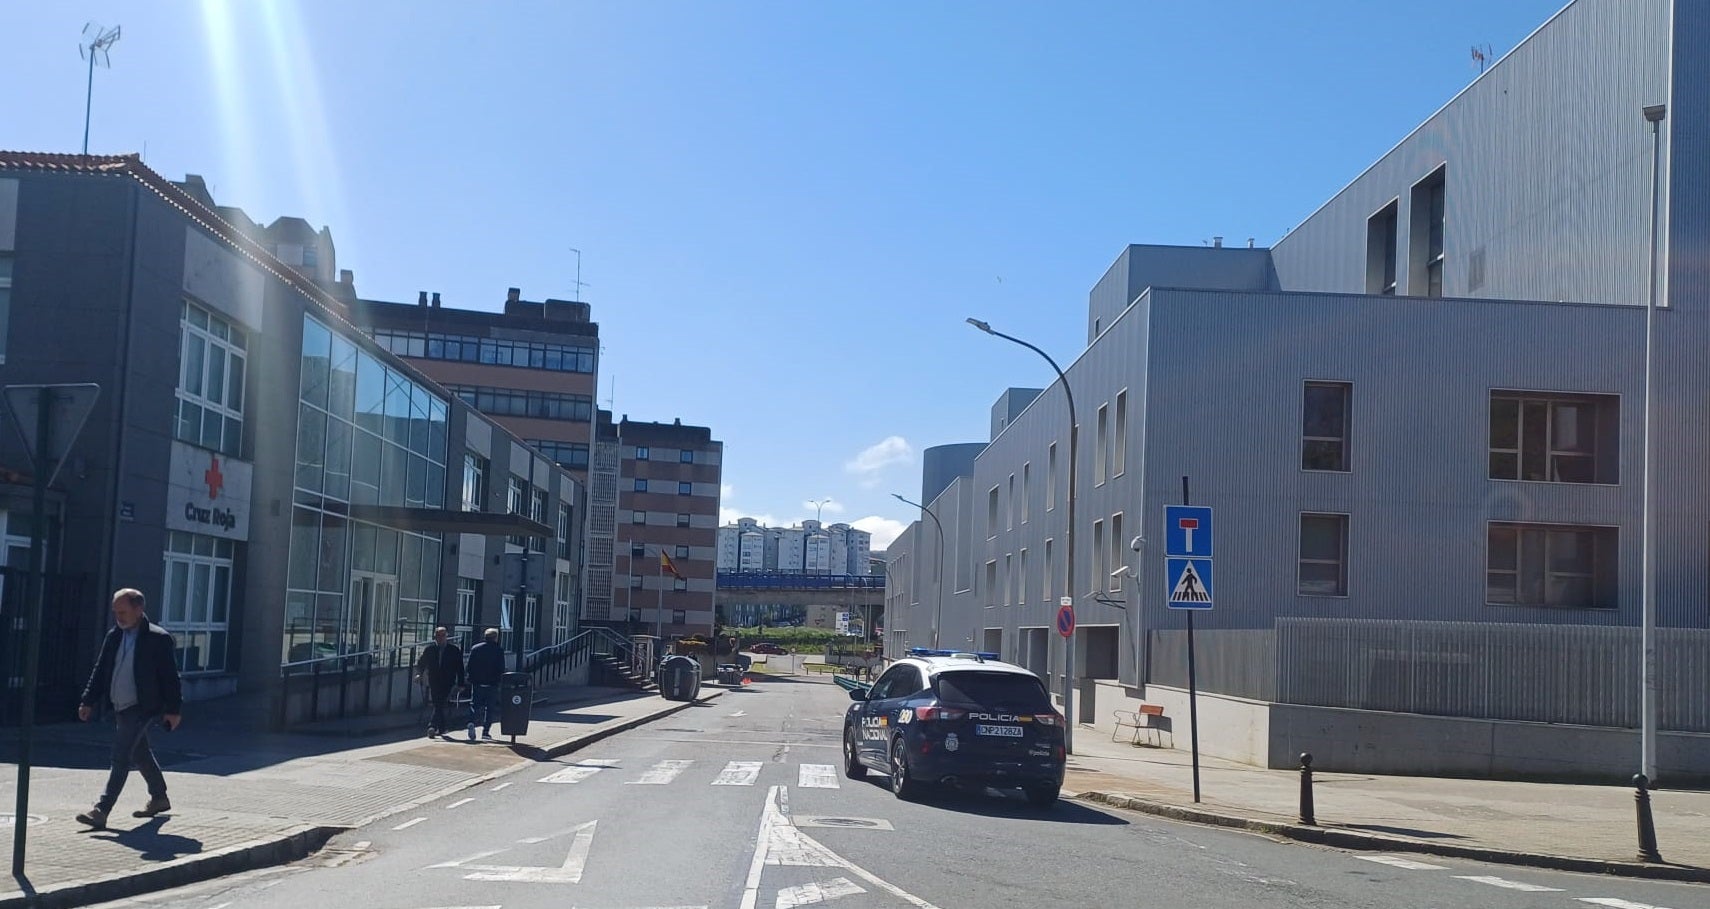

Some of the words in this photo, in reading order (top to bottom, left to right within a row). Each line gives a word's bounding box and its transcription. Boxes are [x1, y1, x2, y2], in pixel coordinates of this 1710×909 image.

[185, 502, 210, 524] Cruz
[212, 507, 236, 531] Roja
[969, 712, 1019, 722] POLICIA
